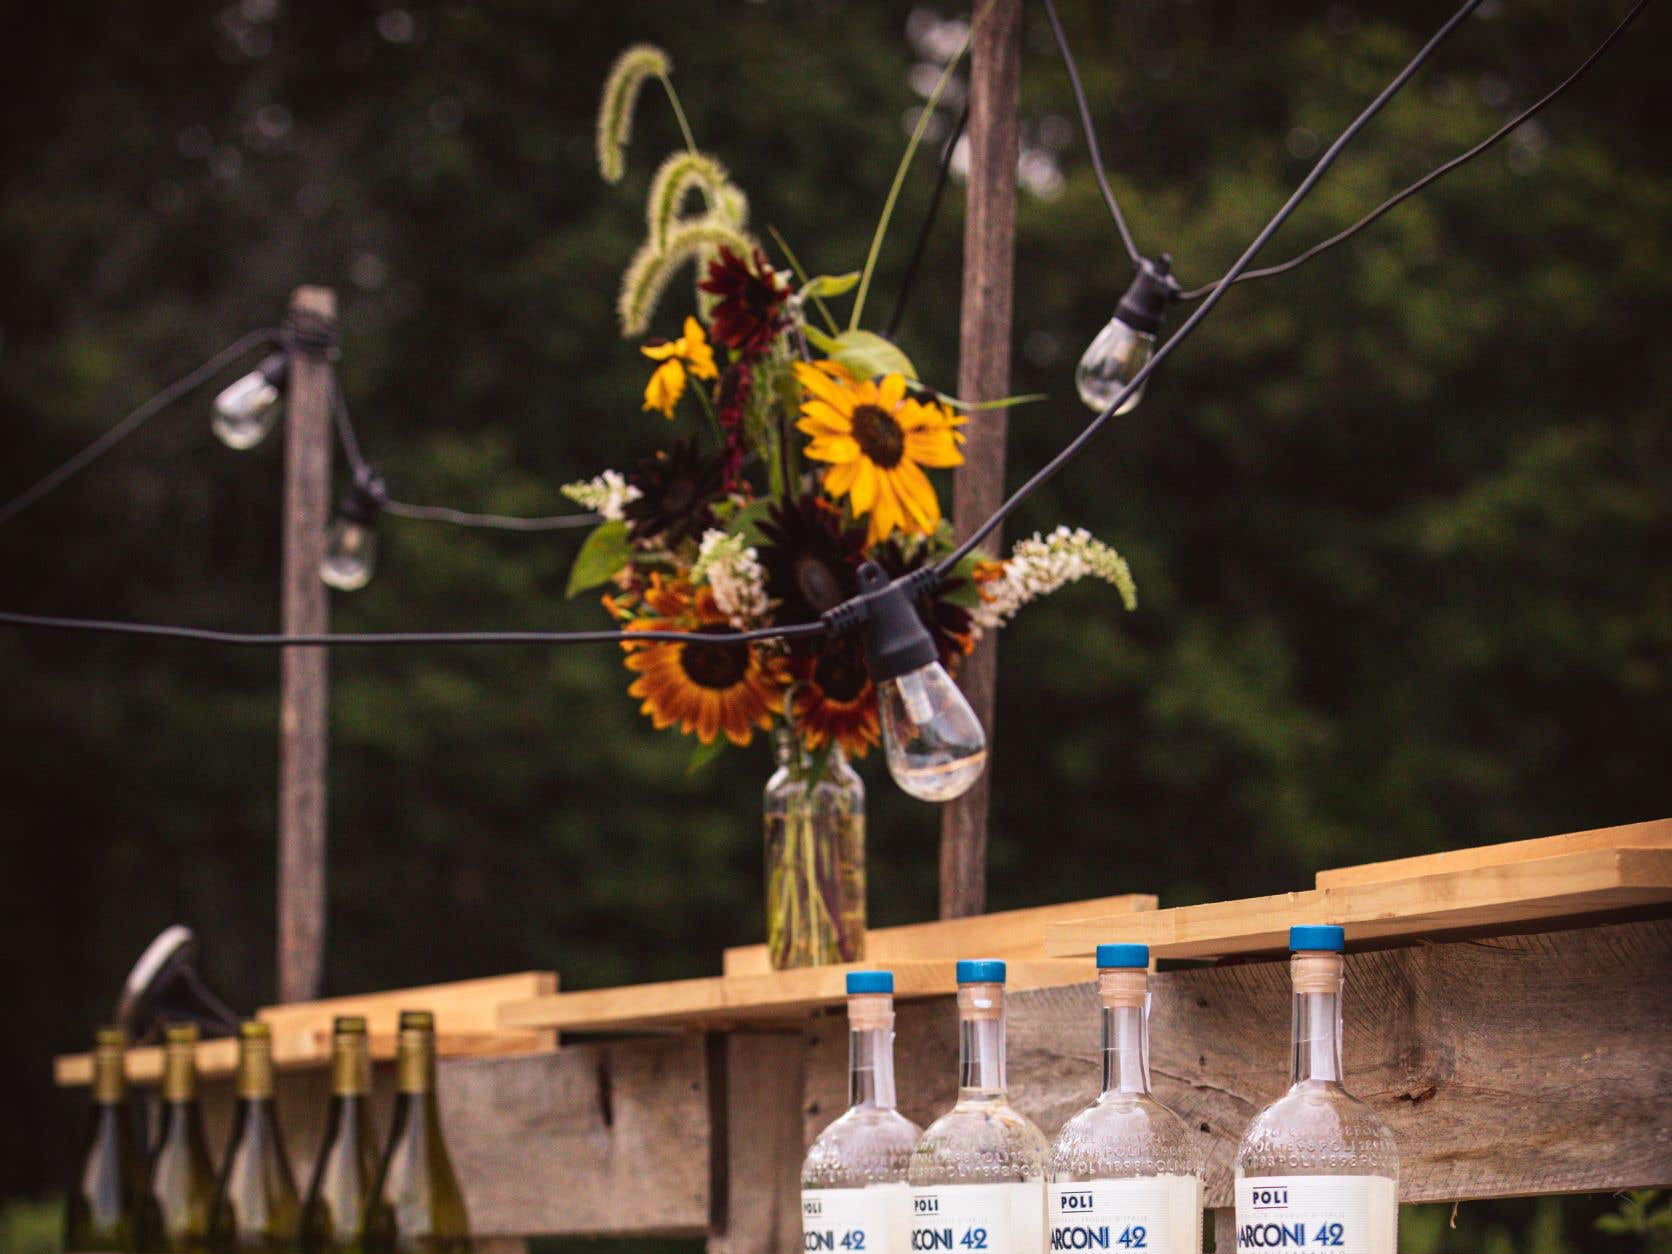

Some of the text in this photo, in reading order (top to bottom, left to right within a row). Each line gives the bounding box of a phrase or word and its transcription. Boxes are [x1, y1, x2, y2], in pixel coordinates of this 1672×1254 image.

[1061, 1194, 1093, 1209] POLI
[1252, 1190, 1288, 1205] POLI
[840, 1228, 866, 1250] 42
[960, 1227, 988, 1249] 42
[1117, 1225, 1147, 1248] 42
[1312, 1221, 1344, 1246] 42
